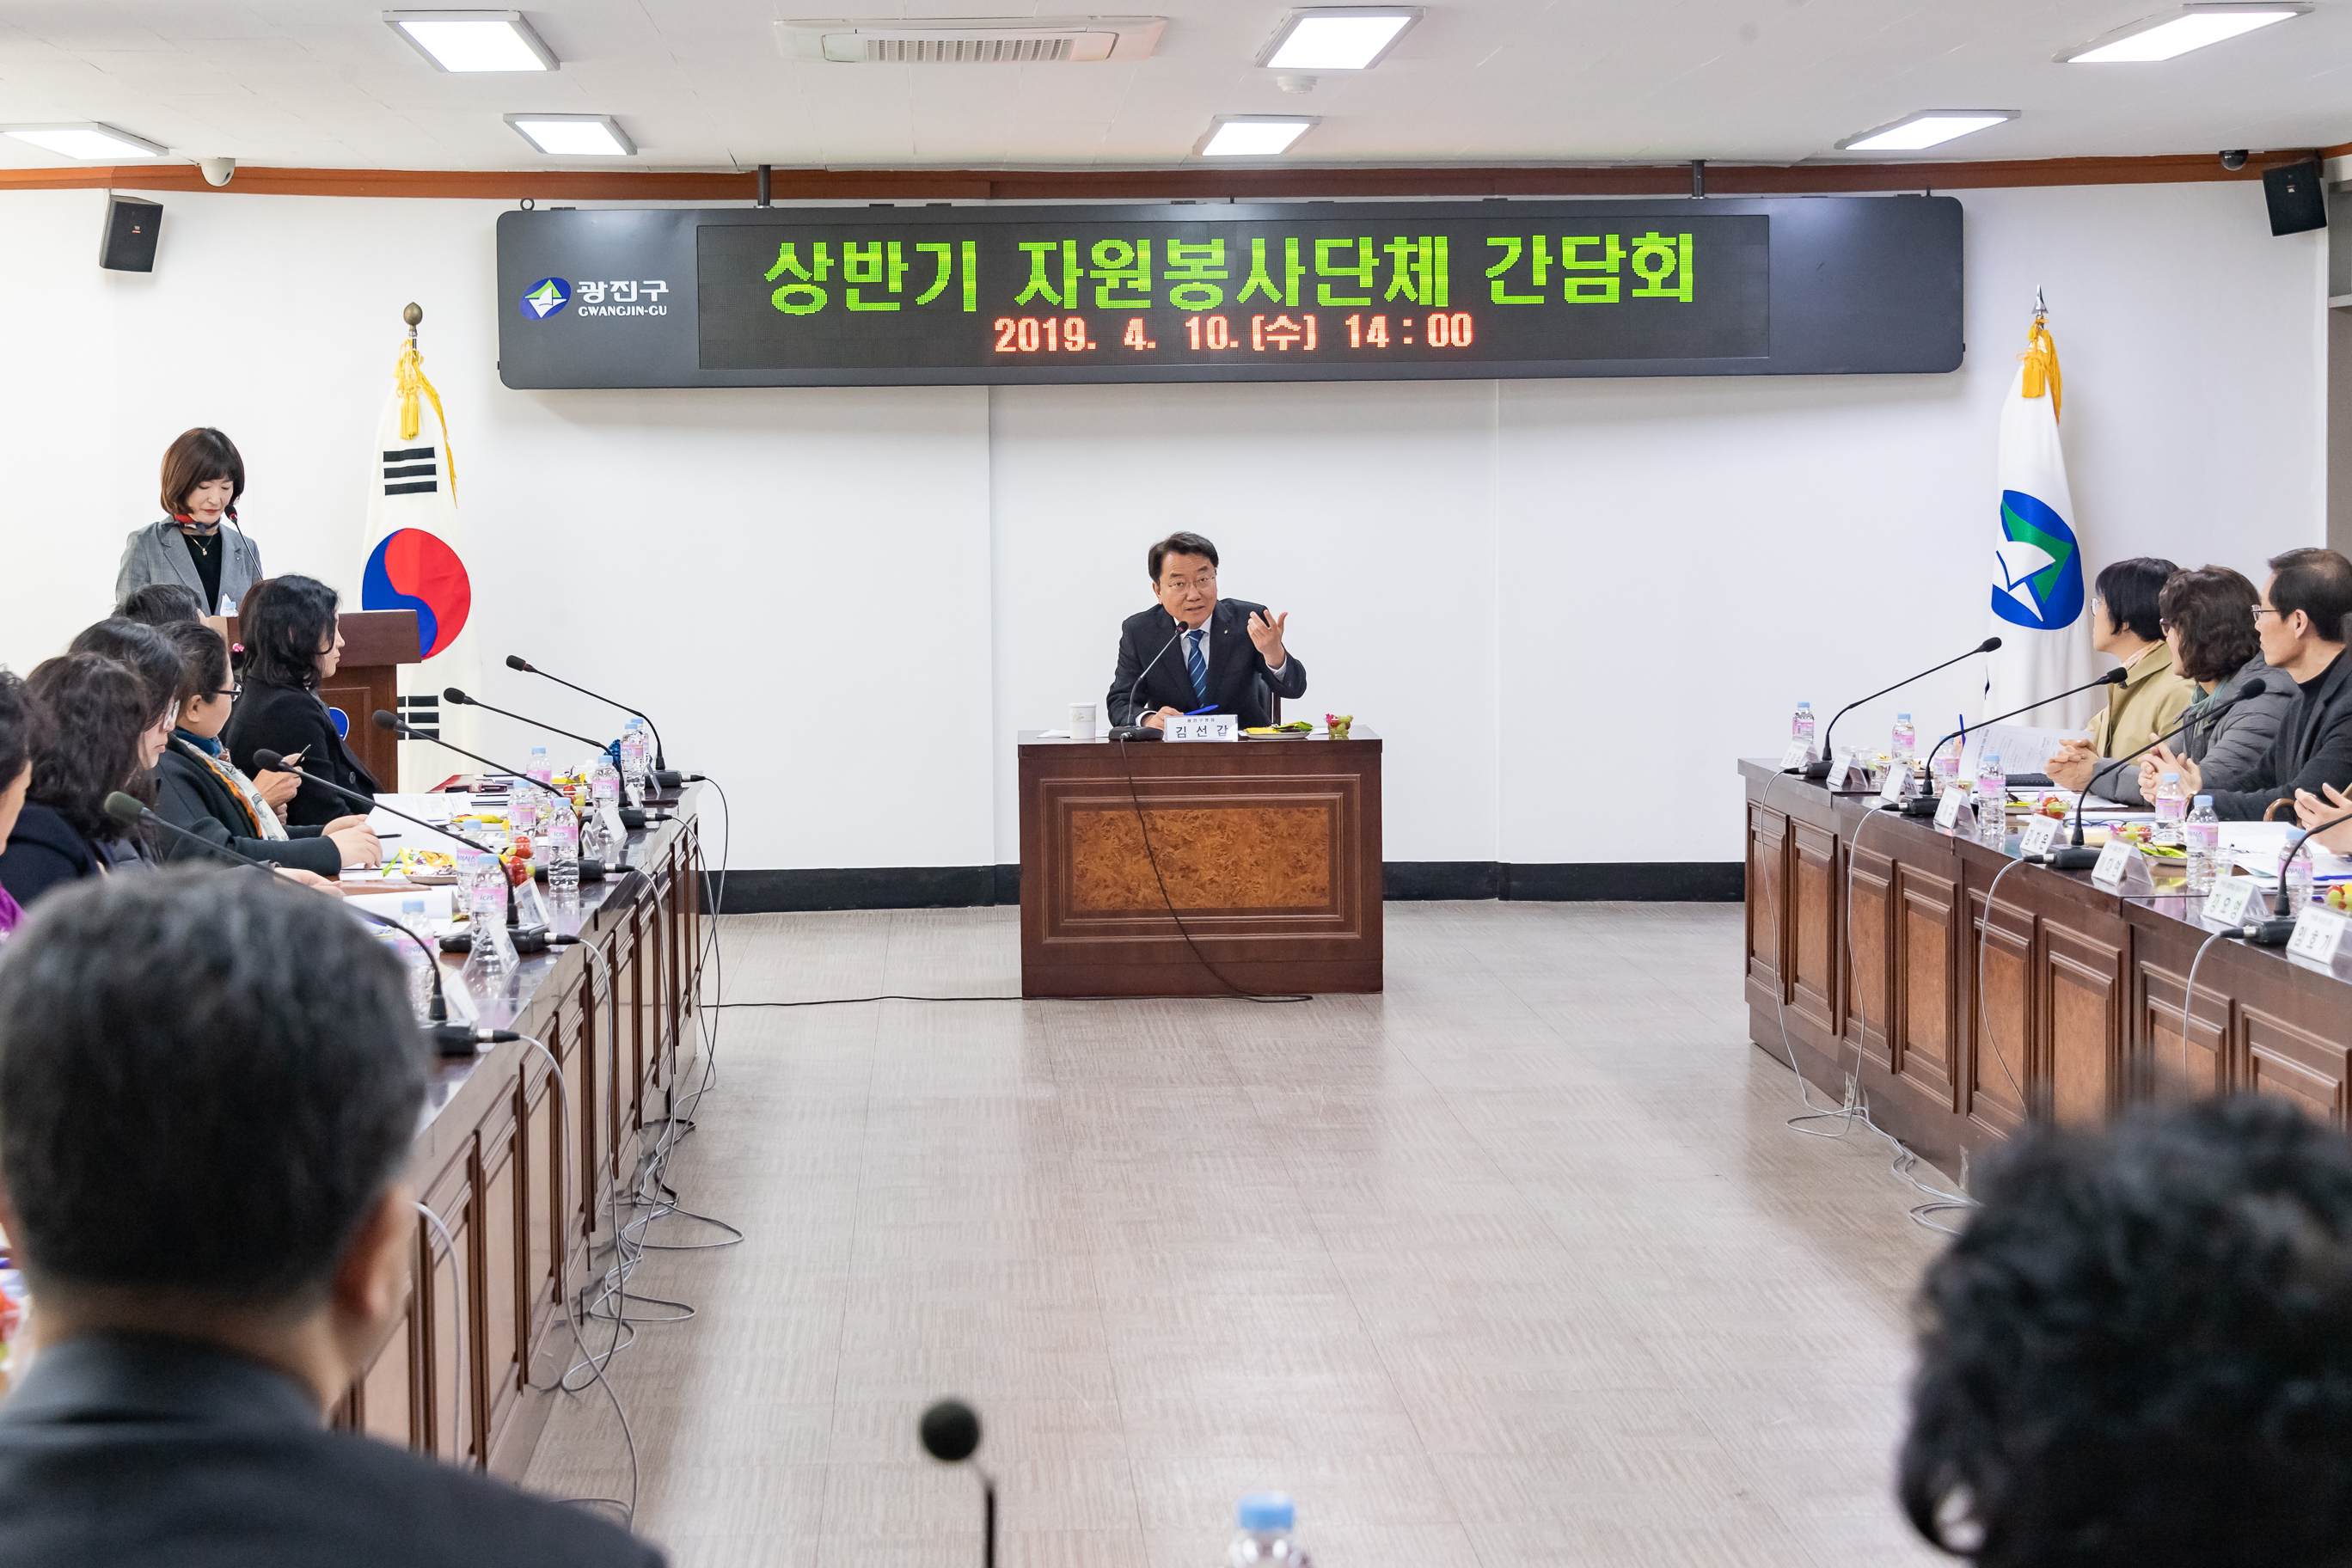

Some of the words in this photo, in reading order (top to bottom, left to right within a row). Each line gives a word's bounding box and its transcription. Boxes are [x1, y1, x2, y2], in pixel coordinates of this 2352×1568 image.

[763, 240, 978, 315] 상반기
[1014, 236, 1449, 311] 자원봉사단체
[1485, 231, 1694, 304] 간담회
[577, 280, 670, 303] 광진구
[578, 305, 668, 317] GWANGJIN-GU
[995, 316, 1097, 352] 2019.
[1123, 316, 1156, 352] 4.
